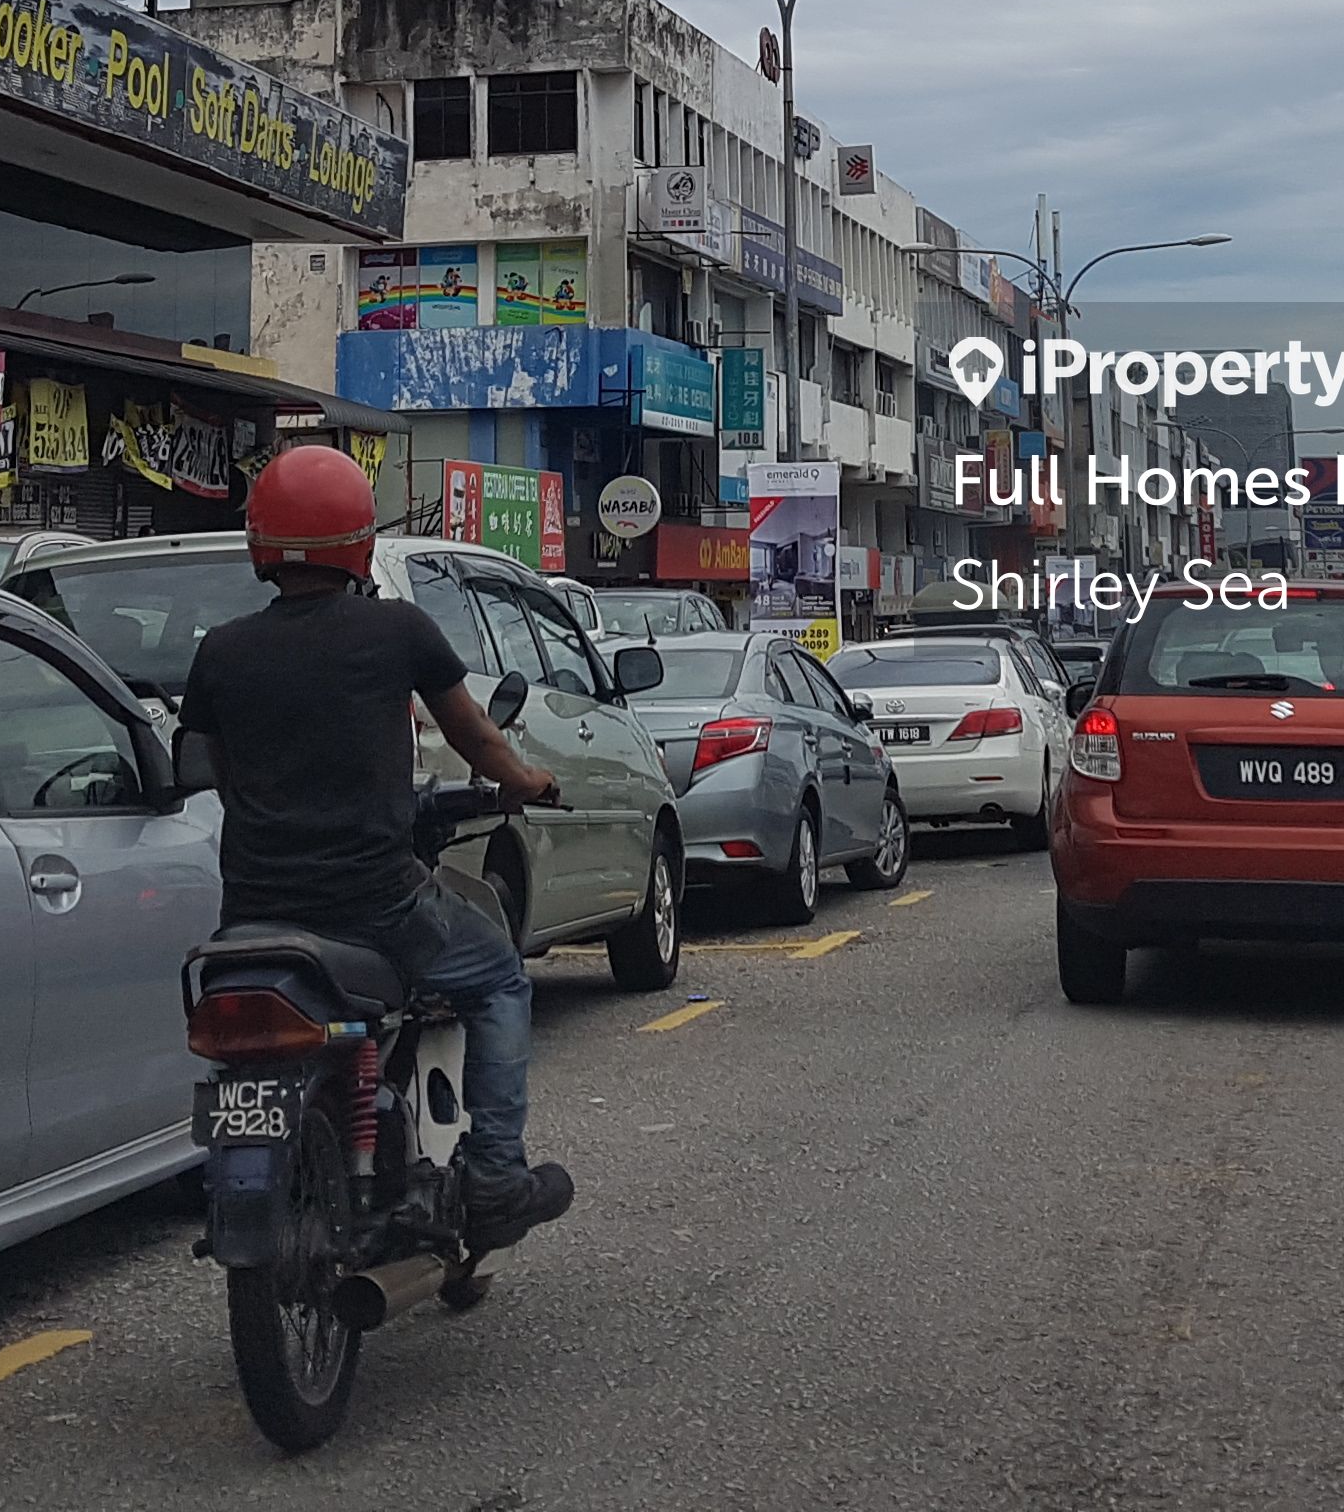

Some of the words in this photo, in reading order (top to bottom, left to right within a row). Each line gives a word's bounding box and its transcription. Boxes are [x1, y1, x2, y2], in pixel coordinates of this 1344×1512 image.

[107, 29, 170, 118] Pool
[190, 65, 236, 148] Soft
[239, 88, 296, 170] Darts
[309, 122, 376, 214] Lounge
[766, 468, 809, 480] emerald
[714, 538, 749, 568] AmBan
[809, 629, 829, 638] 289
[1132, 732, 1175, 741] SUZUKI
[1239, 759, 1283, 784] WVQ
[1293, 761, 1335, 786] 489
[218, 1079, 279, 1110] WCF
